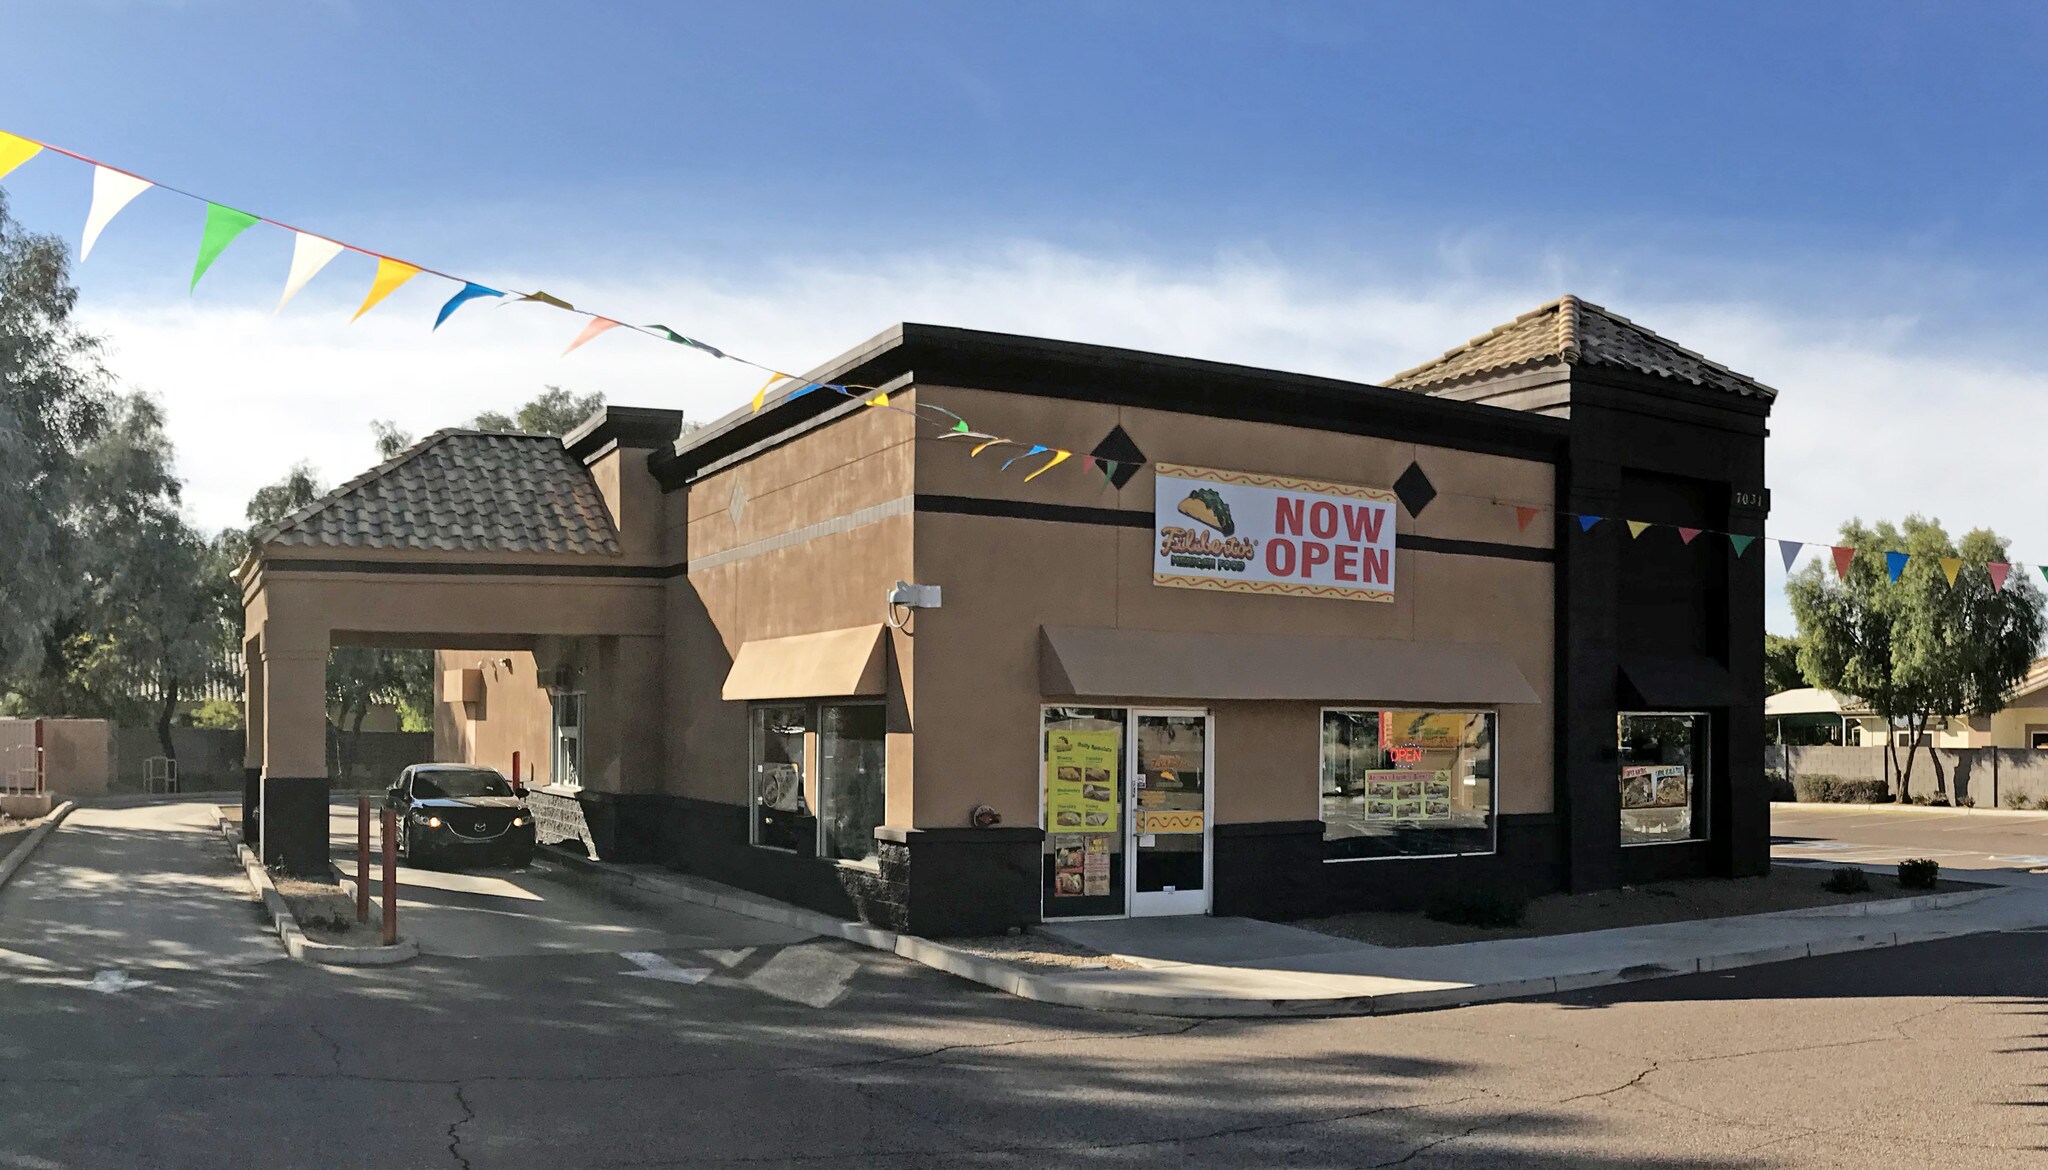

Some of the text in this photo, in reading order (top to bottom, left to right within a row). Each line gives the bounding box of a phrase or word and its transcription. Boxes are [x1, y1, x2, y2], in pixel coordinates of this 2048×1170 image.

[1737, 493, 1762, 506] 7031
[1275, 497, 1385, 544] NOW
[1161, 527, 1254, 560] Filiberto's
[1218, 559, 1245, 572] FOOD
[1266, 538, 1389, 584] OPEN
[1390, 748, 1422, 762] OPEN
